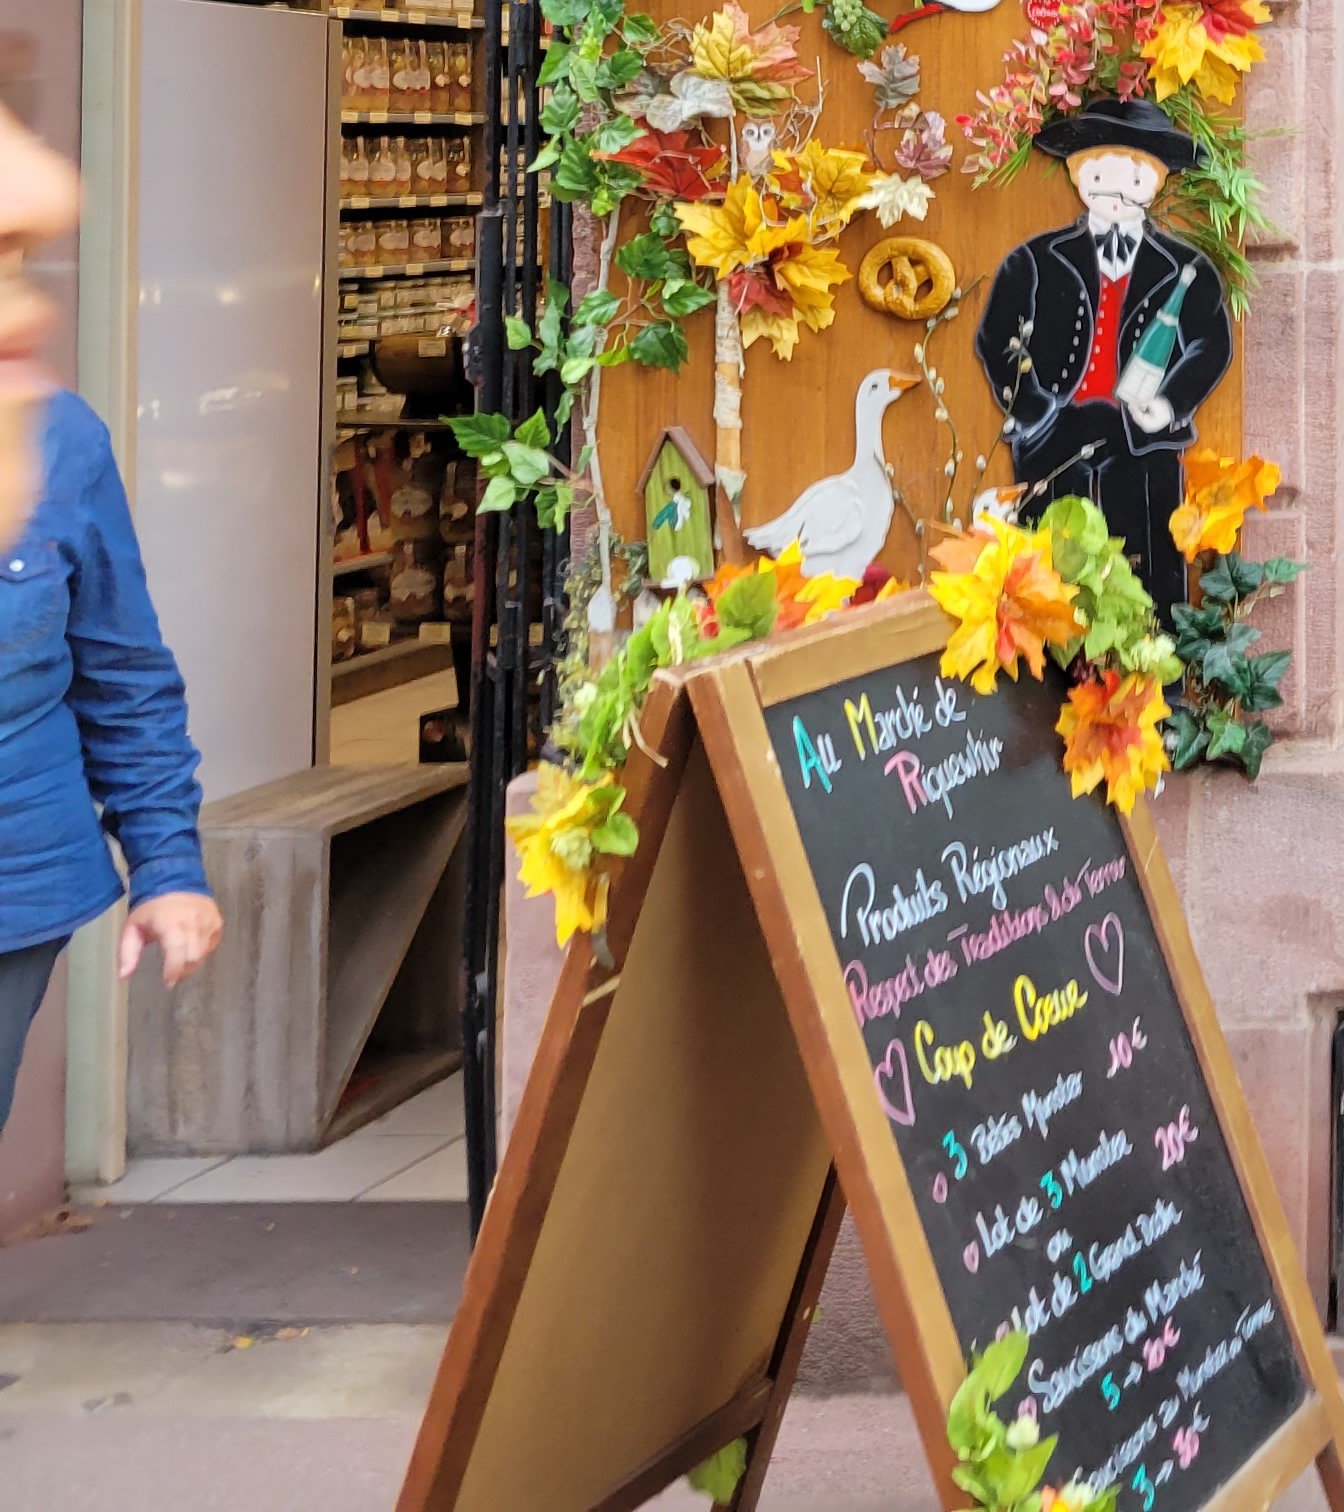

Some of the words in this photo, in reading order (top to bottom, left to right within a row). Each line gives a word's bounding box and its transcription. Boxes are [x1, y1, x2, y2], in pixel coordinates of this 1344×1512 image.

[793, 715, 842, 794] Au
[844, 684, 932, 762] Marché
[935, 675, 967, 727] de
[841, 862, 949, 948] Produits
[941, 826, 1059, 910] Régionaux
[914, 1019, 976, 1090] Coup
[982, 1009, 1018, 1060] de
[942, 1129, 968, 1180] 3
[1106, 1015, 1148, 1080] 10€
[975, 1204, 1016, 1258] Lot
[1016, 1195, 1044, 1235] de
[1040, 1169, 1063, 1209] 3
[1154, 1103, 1199, 1172] 20€
[1051, 1271, 1079, 1318] de
[1072, 1251, 1093, 1294] 2
[1101, 1371, 1121, 1412] 5
[1131, 1463, 1156, 1512] 3
